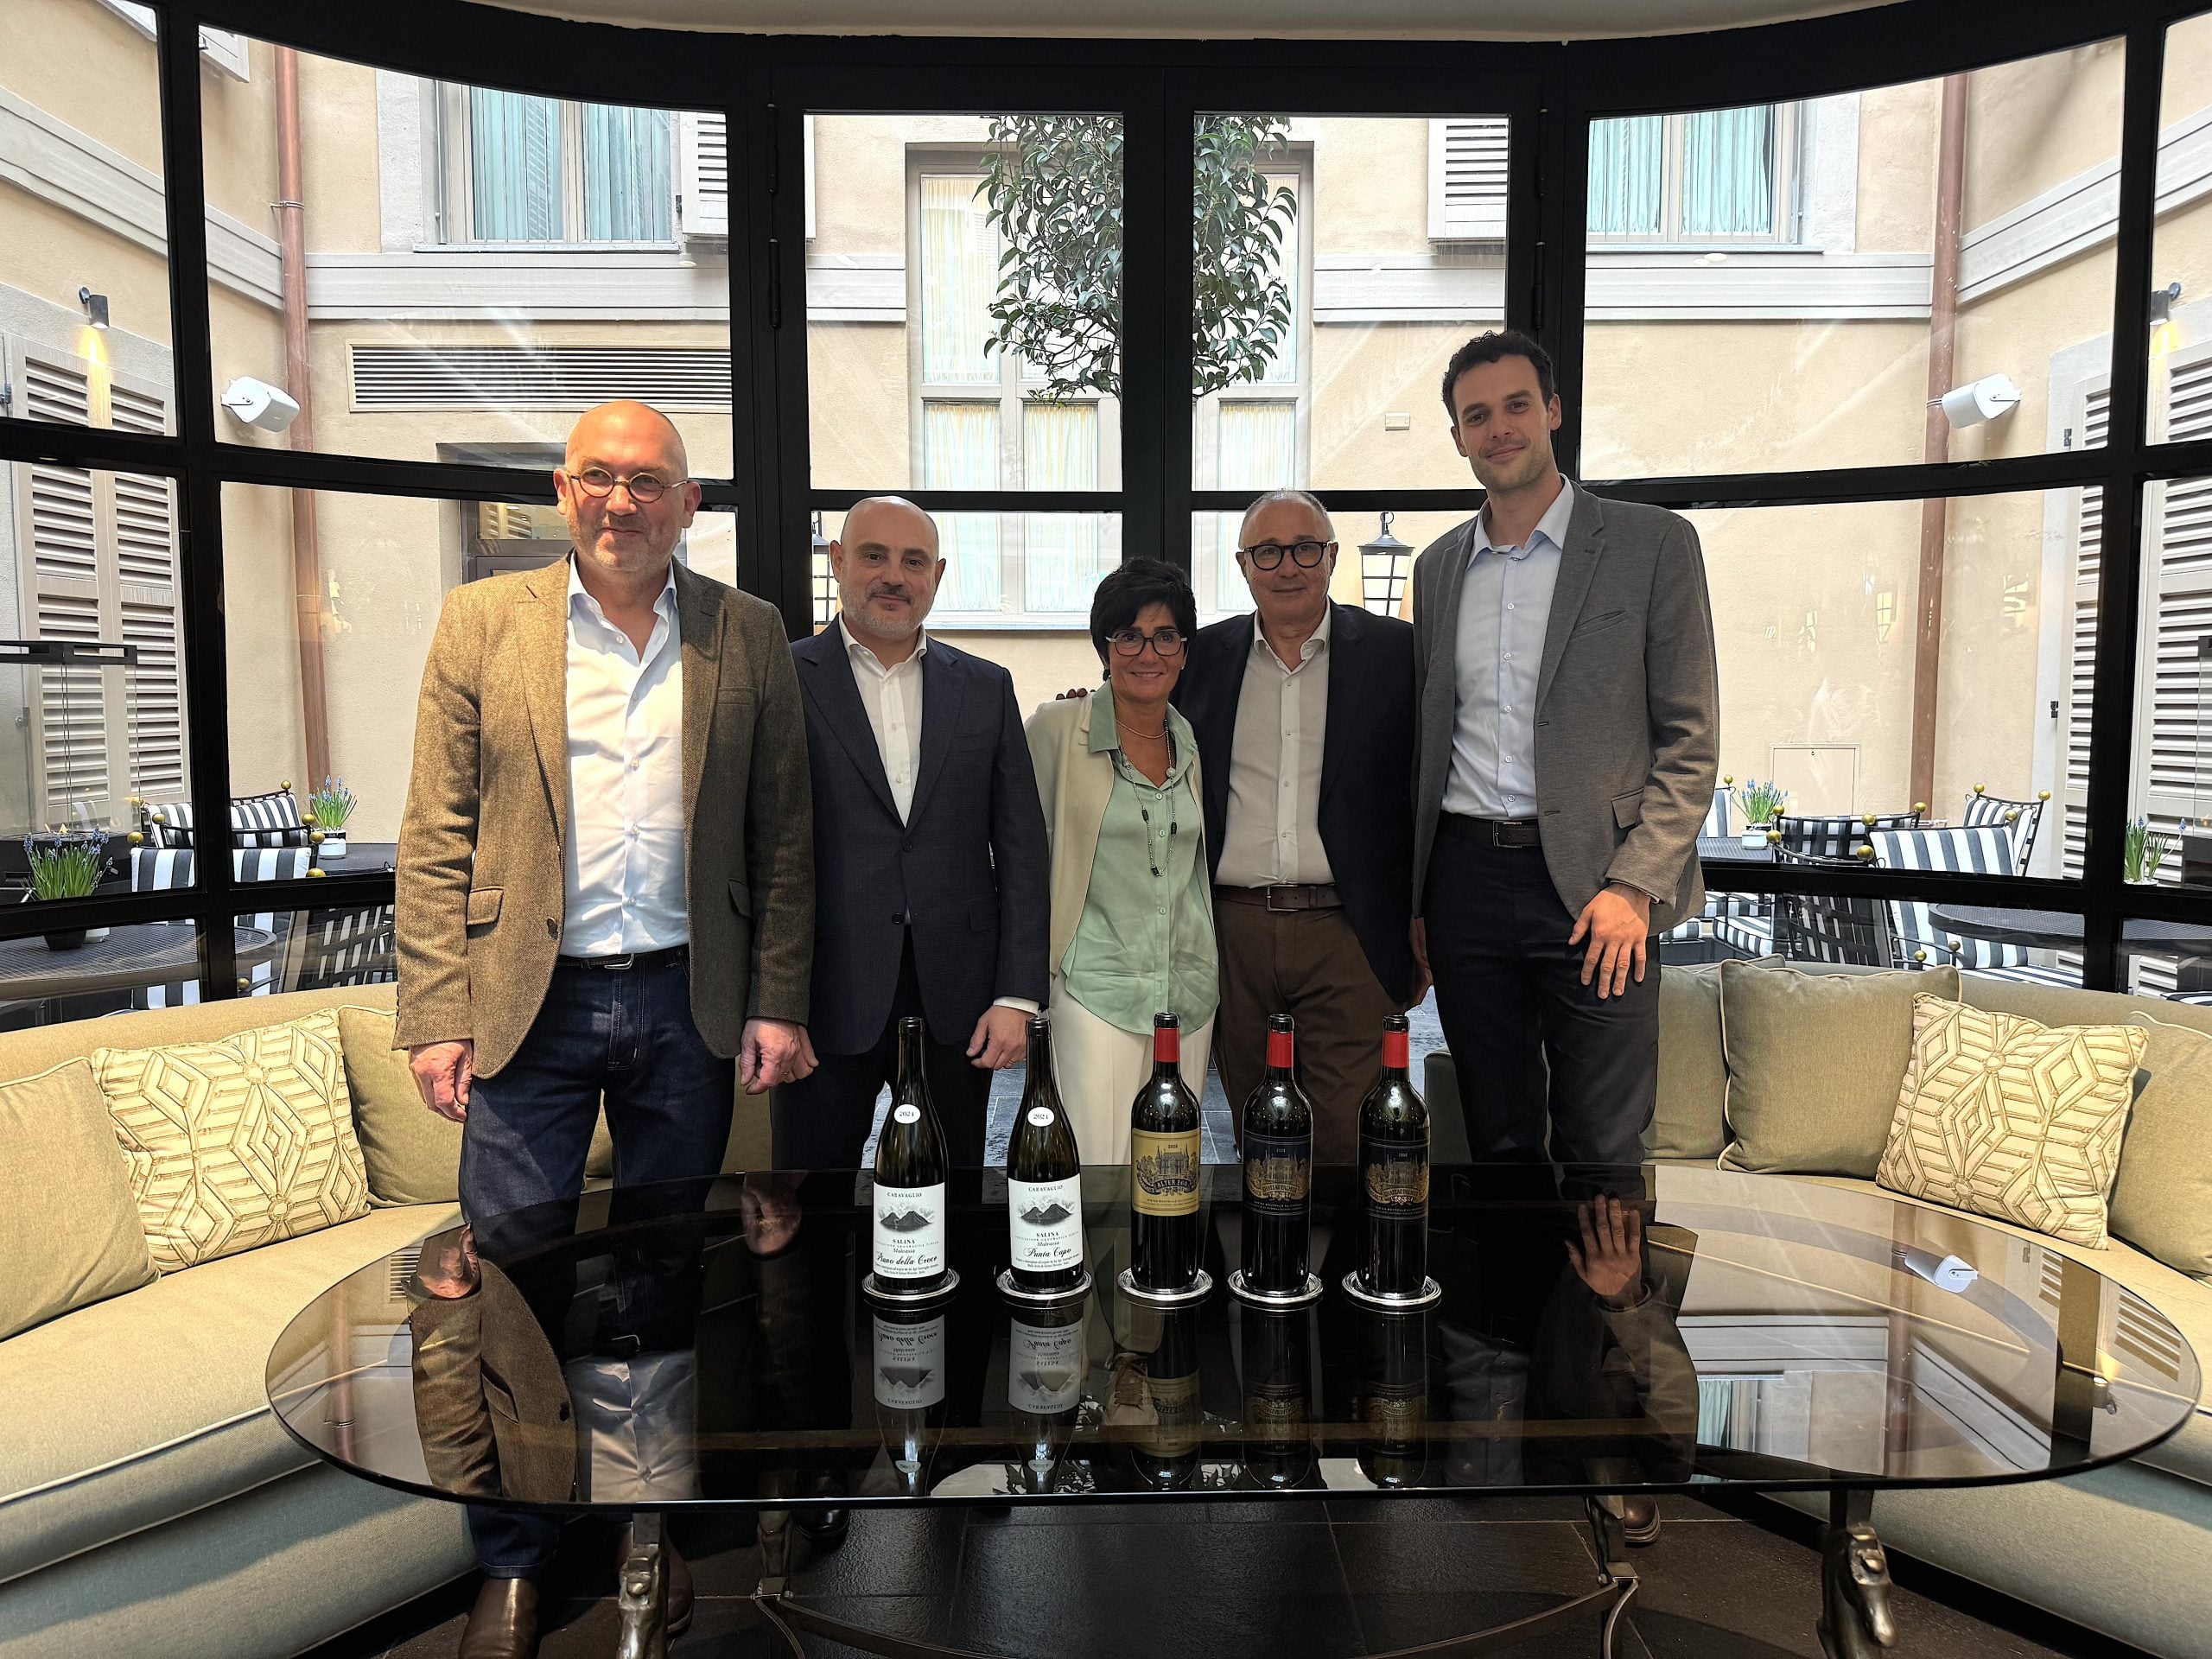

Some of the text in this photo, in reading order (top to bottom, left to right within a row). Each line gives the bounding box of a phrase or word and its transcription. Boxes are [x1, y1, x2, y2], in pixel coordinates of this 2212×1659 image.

[1156, 1179, 1176, 1188] ALTER
[1023, 1247, 1072, 1258] Punta Capo
[895, 1255, 914, 1265] della
[918, 1254, 938, 1265] Croce
